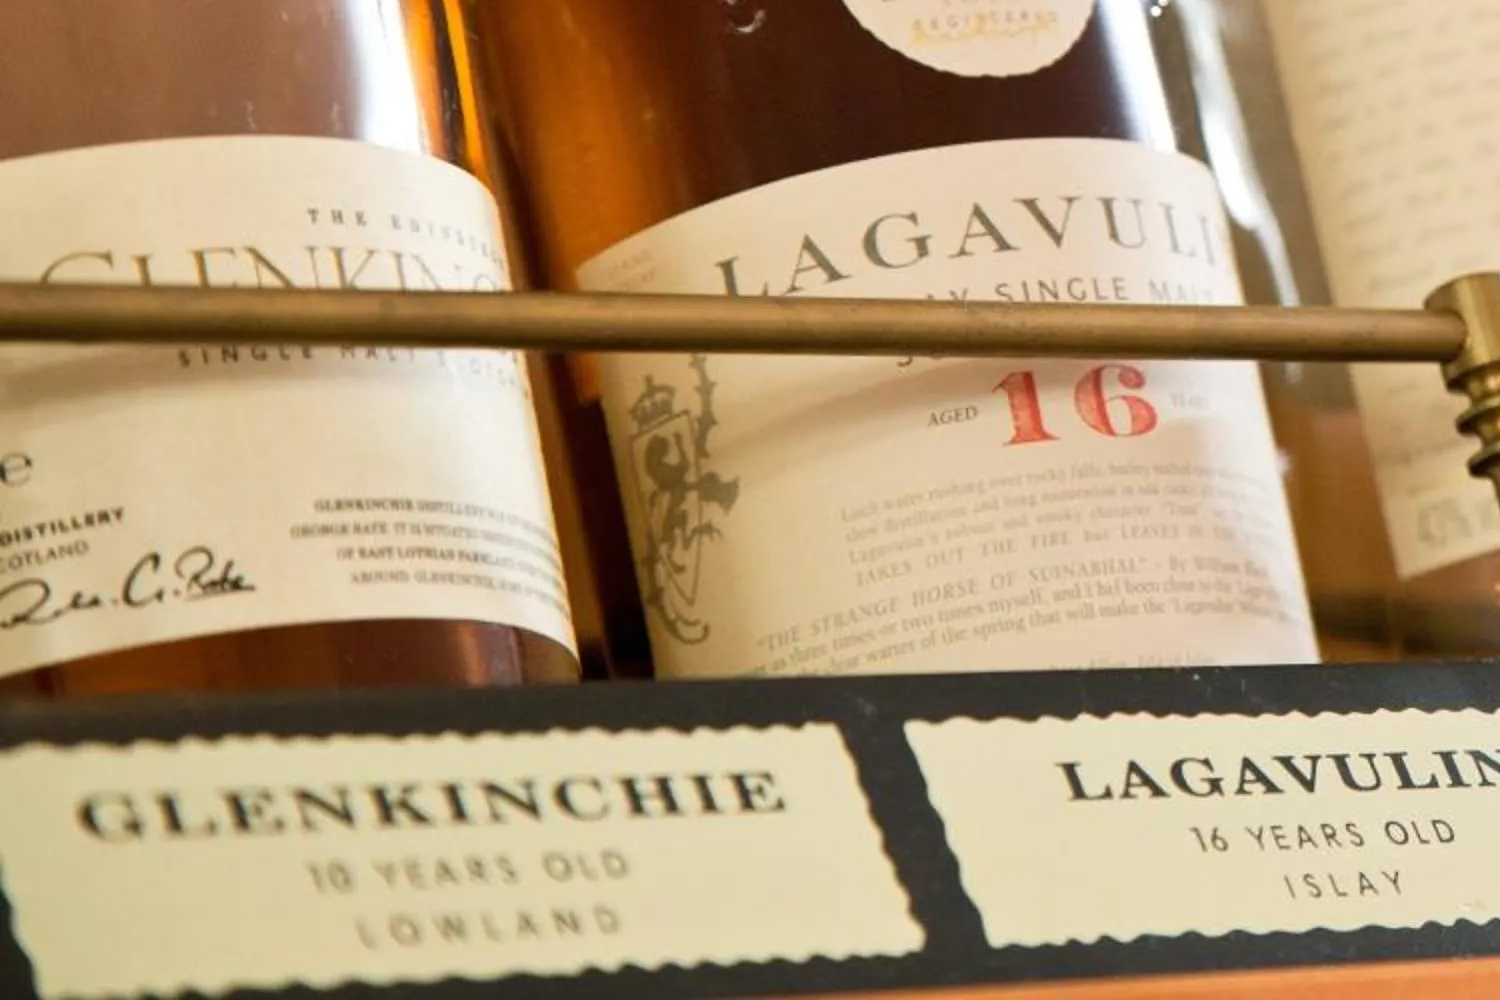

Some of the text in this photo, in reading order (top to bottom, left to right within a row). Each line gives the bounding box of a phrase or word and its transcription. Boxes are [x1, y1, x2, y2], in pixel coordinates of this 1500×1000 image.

[307, 208, 367, 228] THE
[994, 277, 1130, 302] SINGLE
[178, 346, 313, 370] SINGLE
[927, 405, 979, 428] AGED
[992, 363, 1158, 446] 16
[0, 507, 125, 548] DISTILLERY
[0, 540, 90, 576] OTLAND
[856, 560, 914, 588] TAKES
[925, 547, 965, 570] OUT
[981, 539, 1018, 559] THE
[1031, 531, 1069, 549] FIRE
[1120, 524, 1180, 540] LEAVES
[809, 595, 898, 638] STRANGE
[911, 576, 978, 608] HORSE
[990, 571, 1016, 590] OF
[901, 612, 935, 633] two
[938, 602, 986, 623] times
[1053, 585, 1082, 603] and
[921, 629, 939, 650] of
[942, 625, 969, 645] the
[973, 614, 1028, 644] spring
[1029, 607, 1063, 629] that
[1065, 600, 1098, 622] will
[1100, 597, 1142, 619] make
[77, 769, 787, 844] GLENKINCHIE
[1188, 817, 1459, 856] 16 YEARS OLD
[305, 847, 633, 896] 10 YEARS OLD
[1281, 870, 1407, 901] ISLAY
[356, 903, 627, 953] LOWLAND
